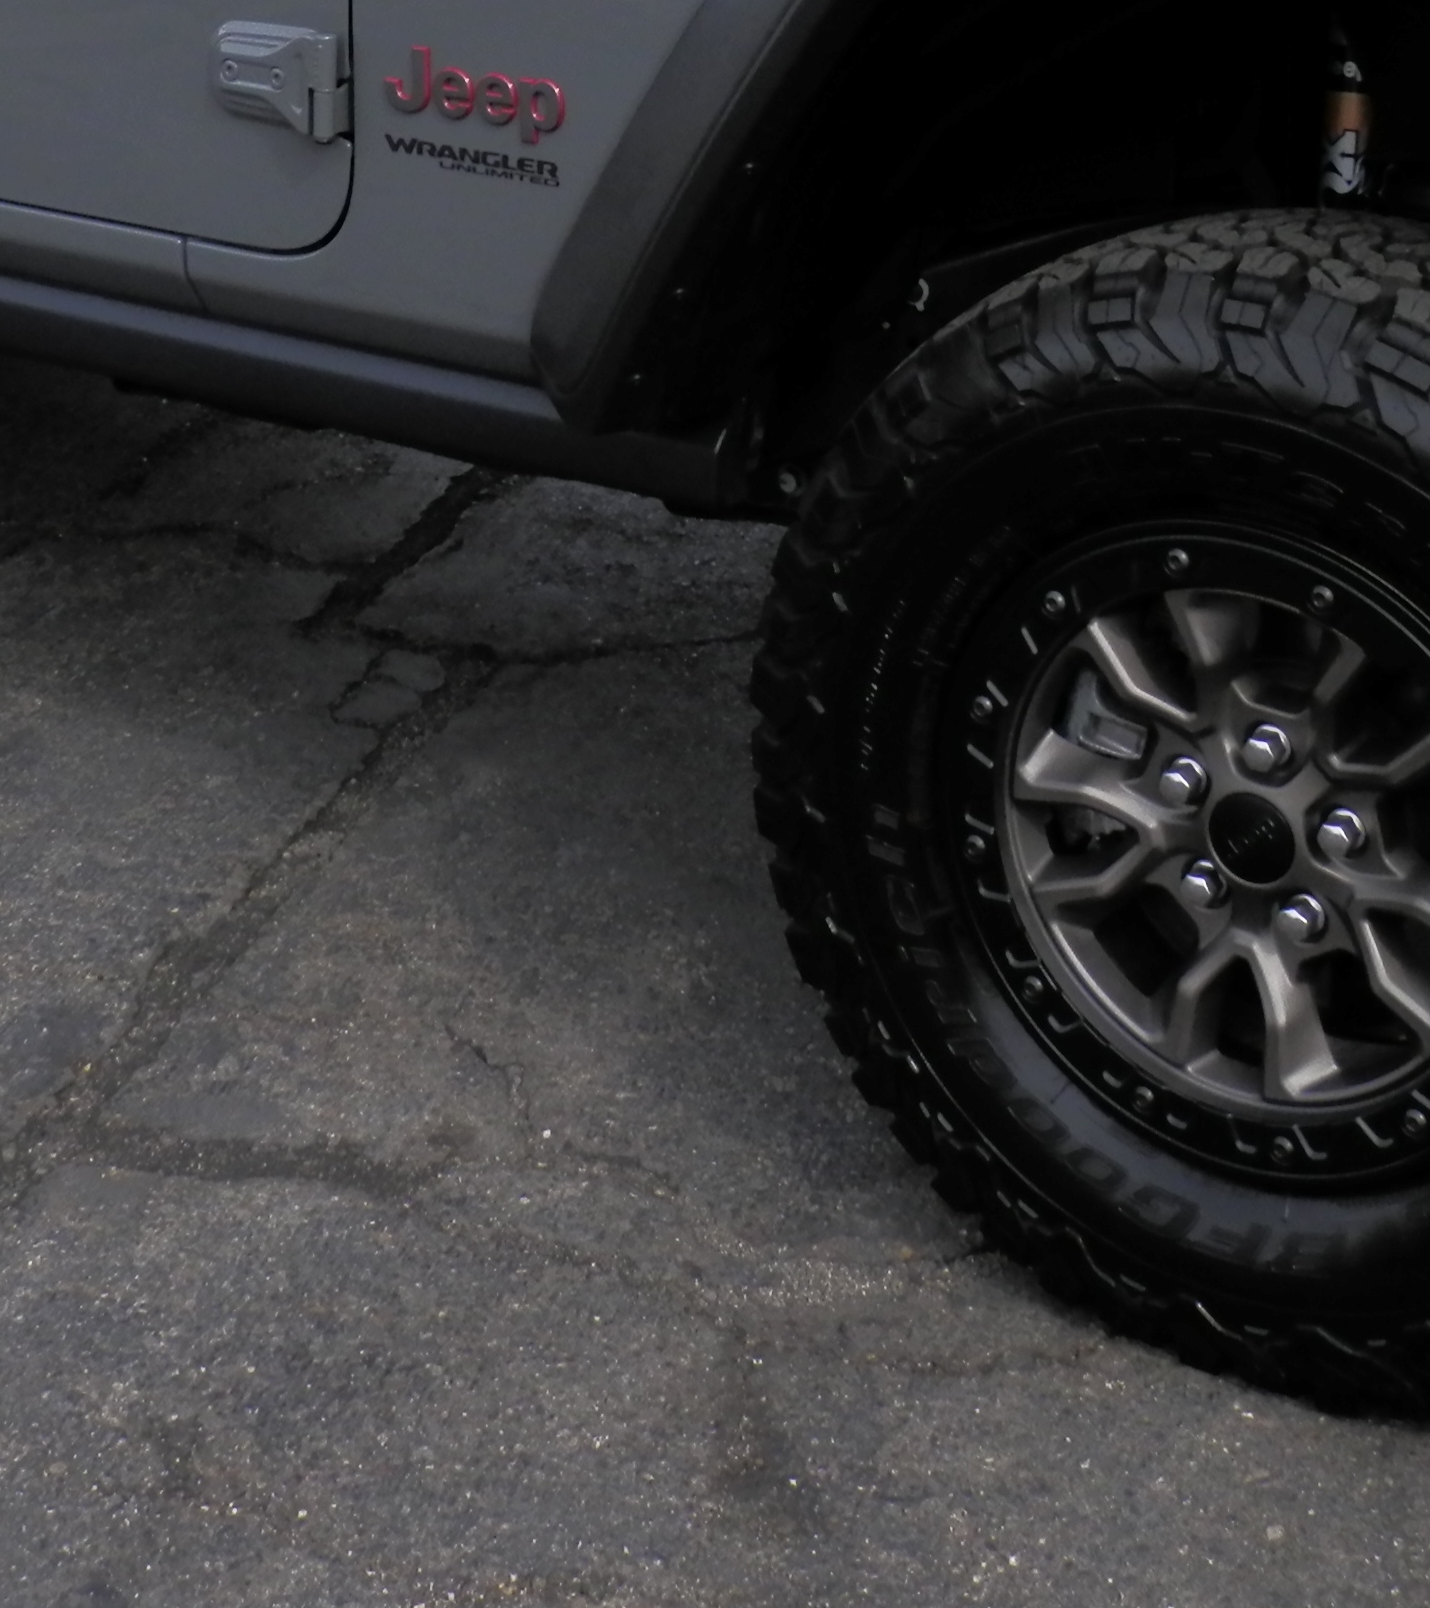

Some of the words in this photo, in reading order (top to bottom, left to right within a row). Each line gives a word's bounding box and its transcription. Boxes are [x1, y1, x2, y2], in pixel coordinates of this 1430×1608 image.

[383, 44, 566, 147] Jeep
[384, 134, 560, 179] WRANGLER
[438, 161, 561, 188] UNLIMITED
